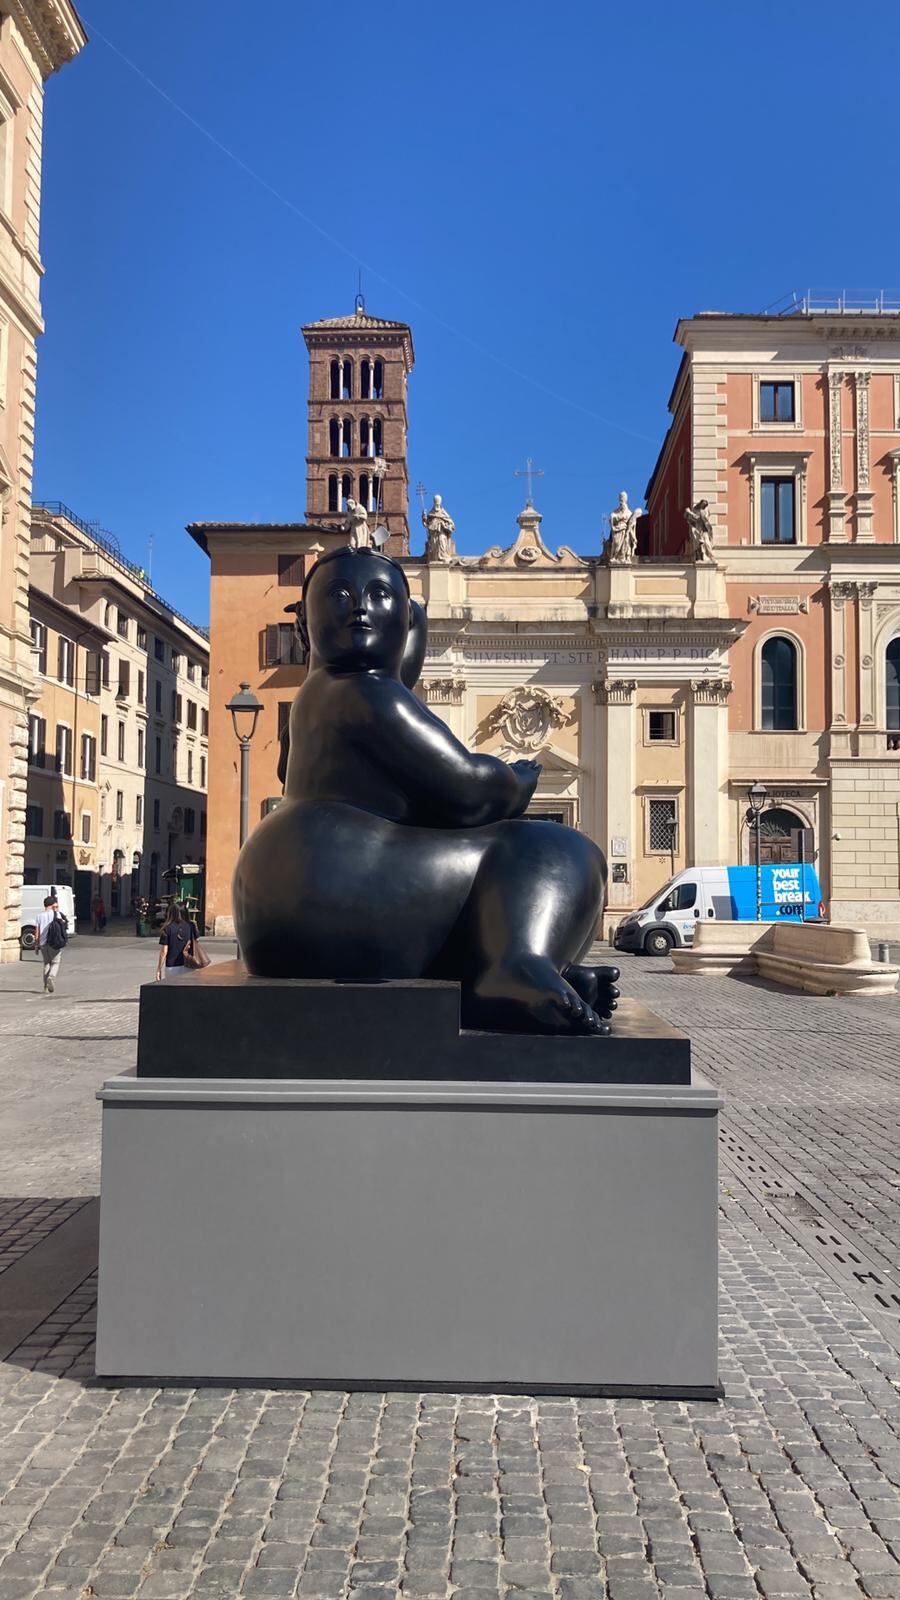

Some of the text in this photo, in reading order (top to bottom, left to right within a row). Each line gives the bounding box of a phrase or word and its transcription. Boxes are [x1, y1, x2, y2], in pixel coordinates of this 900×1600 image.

[464, 651, 534, 663] SILVESTRI
[543, 652, 560, 664] ET
[767, 790, 801, 798] LIOTECA
[771, 869, 800, 881] your
[773, 879, 800, 891] best
[774, 890, 811, 903] break
[776, 904, 804, 916] .com
